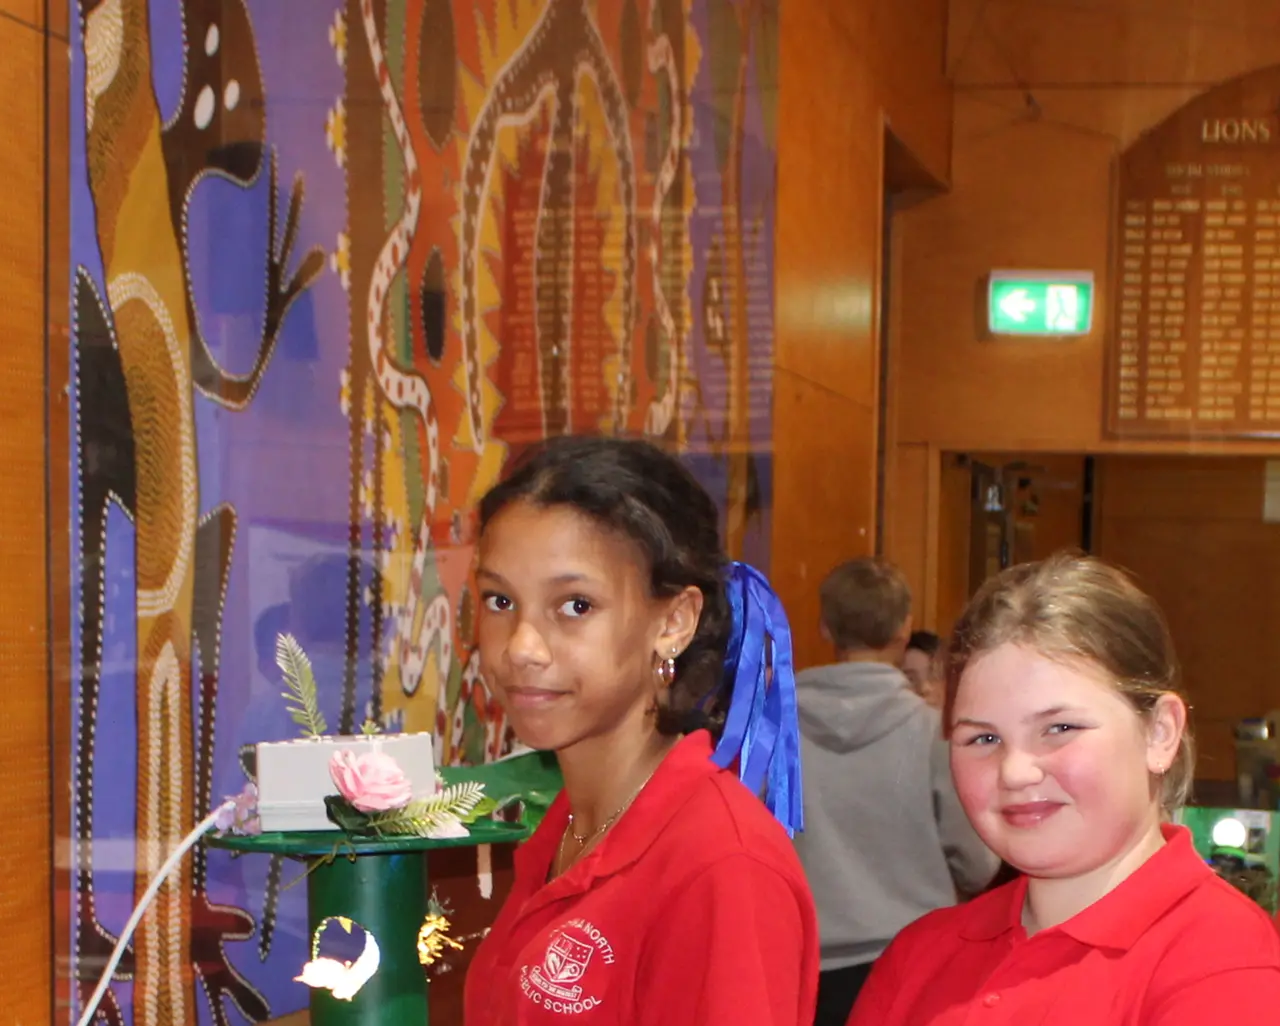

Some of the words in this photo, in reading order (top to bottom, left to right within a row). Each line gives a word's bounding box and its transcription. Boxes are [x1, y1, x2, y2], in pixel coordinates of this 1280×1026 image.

[1202, 119, 1270, 142] LIONS
[583, 921, 616, 965] NORTH
[543, 995, 602, 1015] SCHOOL
